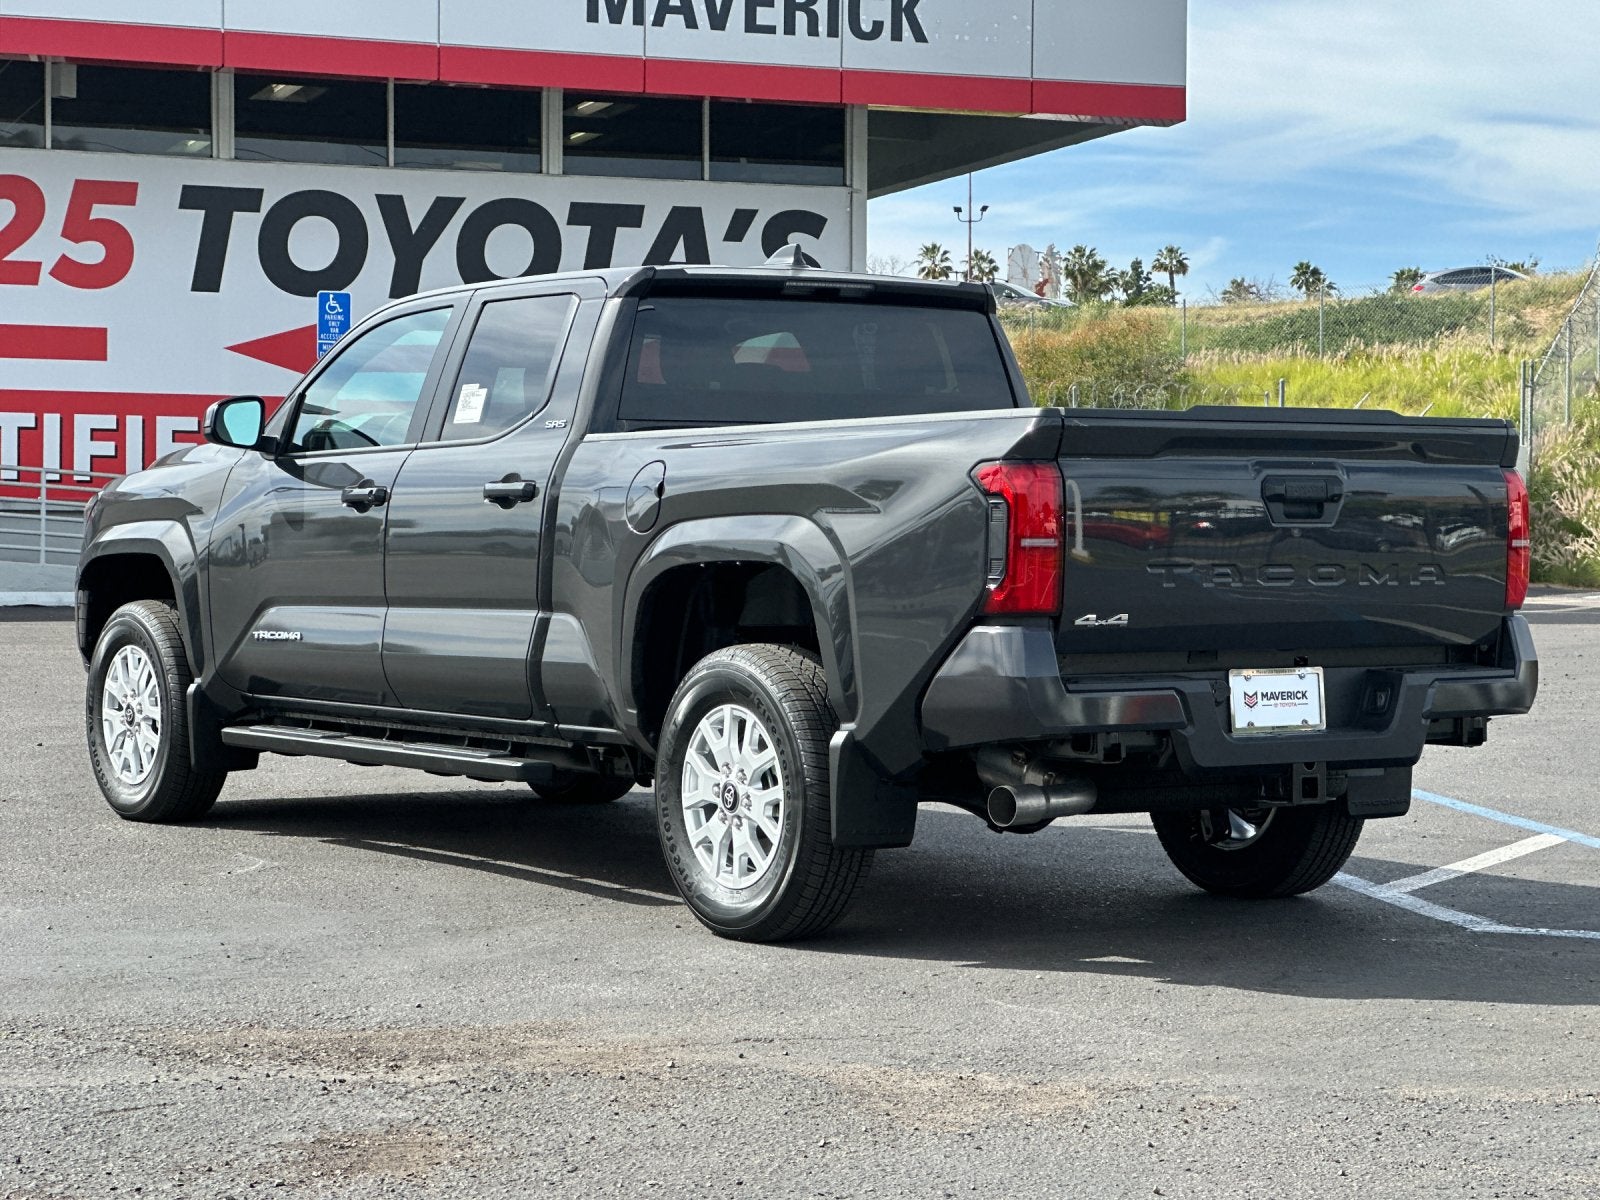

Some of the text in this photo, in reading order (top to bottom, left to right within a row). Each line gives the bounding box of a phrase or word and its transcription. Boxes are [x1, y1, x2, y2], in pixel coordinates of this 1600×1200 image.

[1146, 563, 1446, 588] TACOMA
[252, 630, 301, 640] TACOMA
[1261, 690, 1308, 701] MAVERICK
